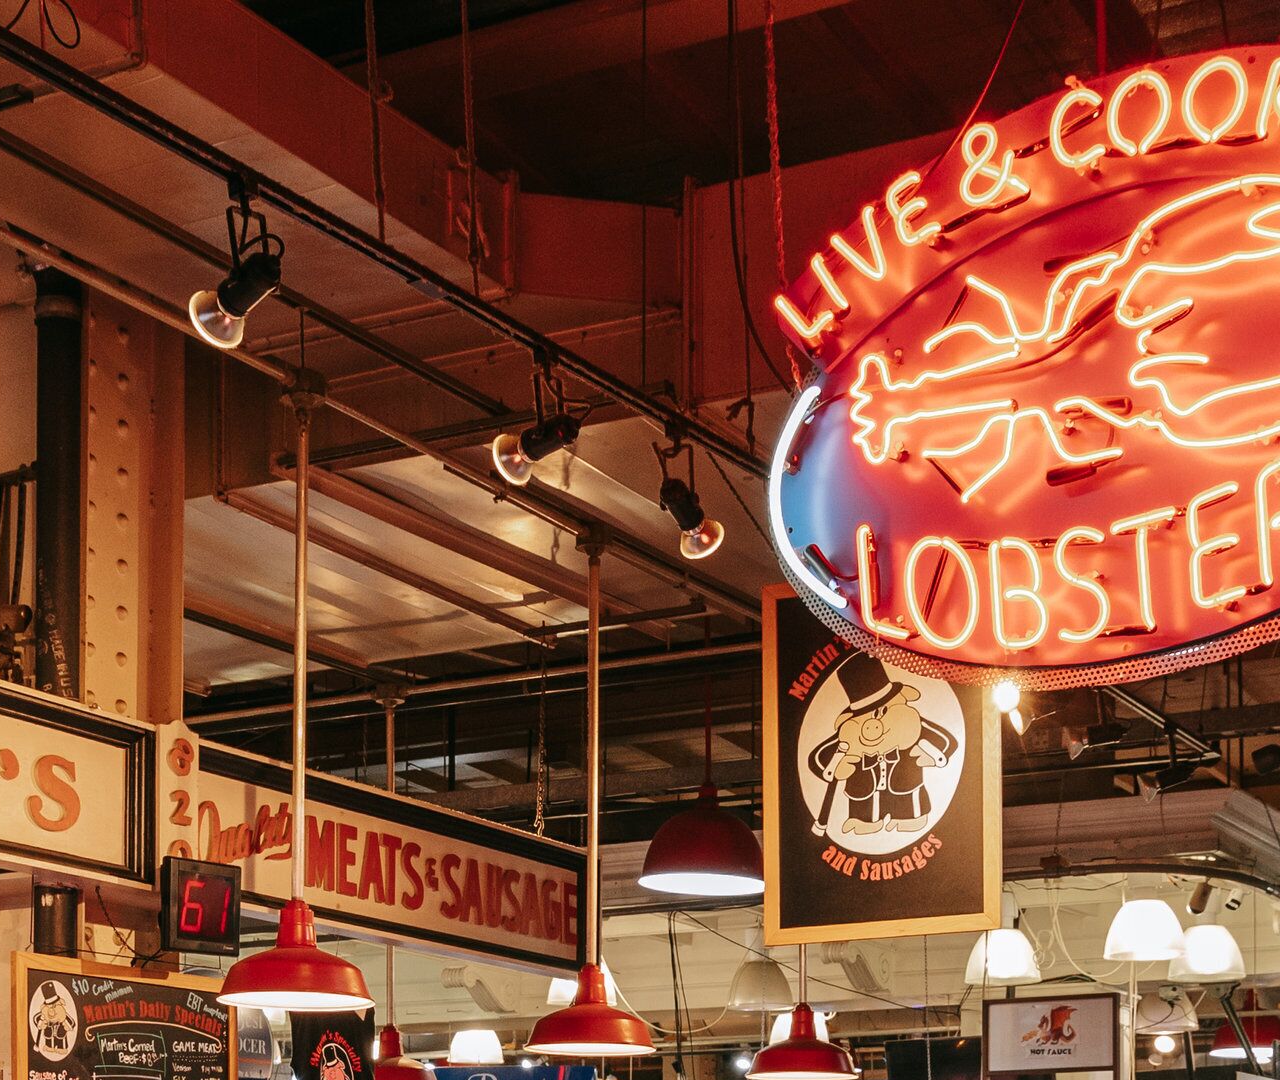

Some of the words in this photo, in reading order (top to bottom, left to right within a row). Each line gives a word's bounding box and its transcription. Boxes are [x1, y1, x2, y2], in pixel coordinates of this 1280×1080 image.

[774, 171, 940, 340] LIVE
[960, 122, 1030, 208] &
[303, 815, 425, 911] MEATS
[425, 856, 441, 893] &
[821, 843, 856, 878] and
[860, 832, 944, 882] Sausages
[180, 879, 231, 934] 61
[72, 978, 89, 996] $10
[83, 1000, 135, 1023] Martin's
[172, 1040, 196, 1053] GAME
[1030, 1046, 1046, 1056] HOT
[1047, 1046, 1073, 1056] SAUCE
